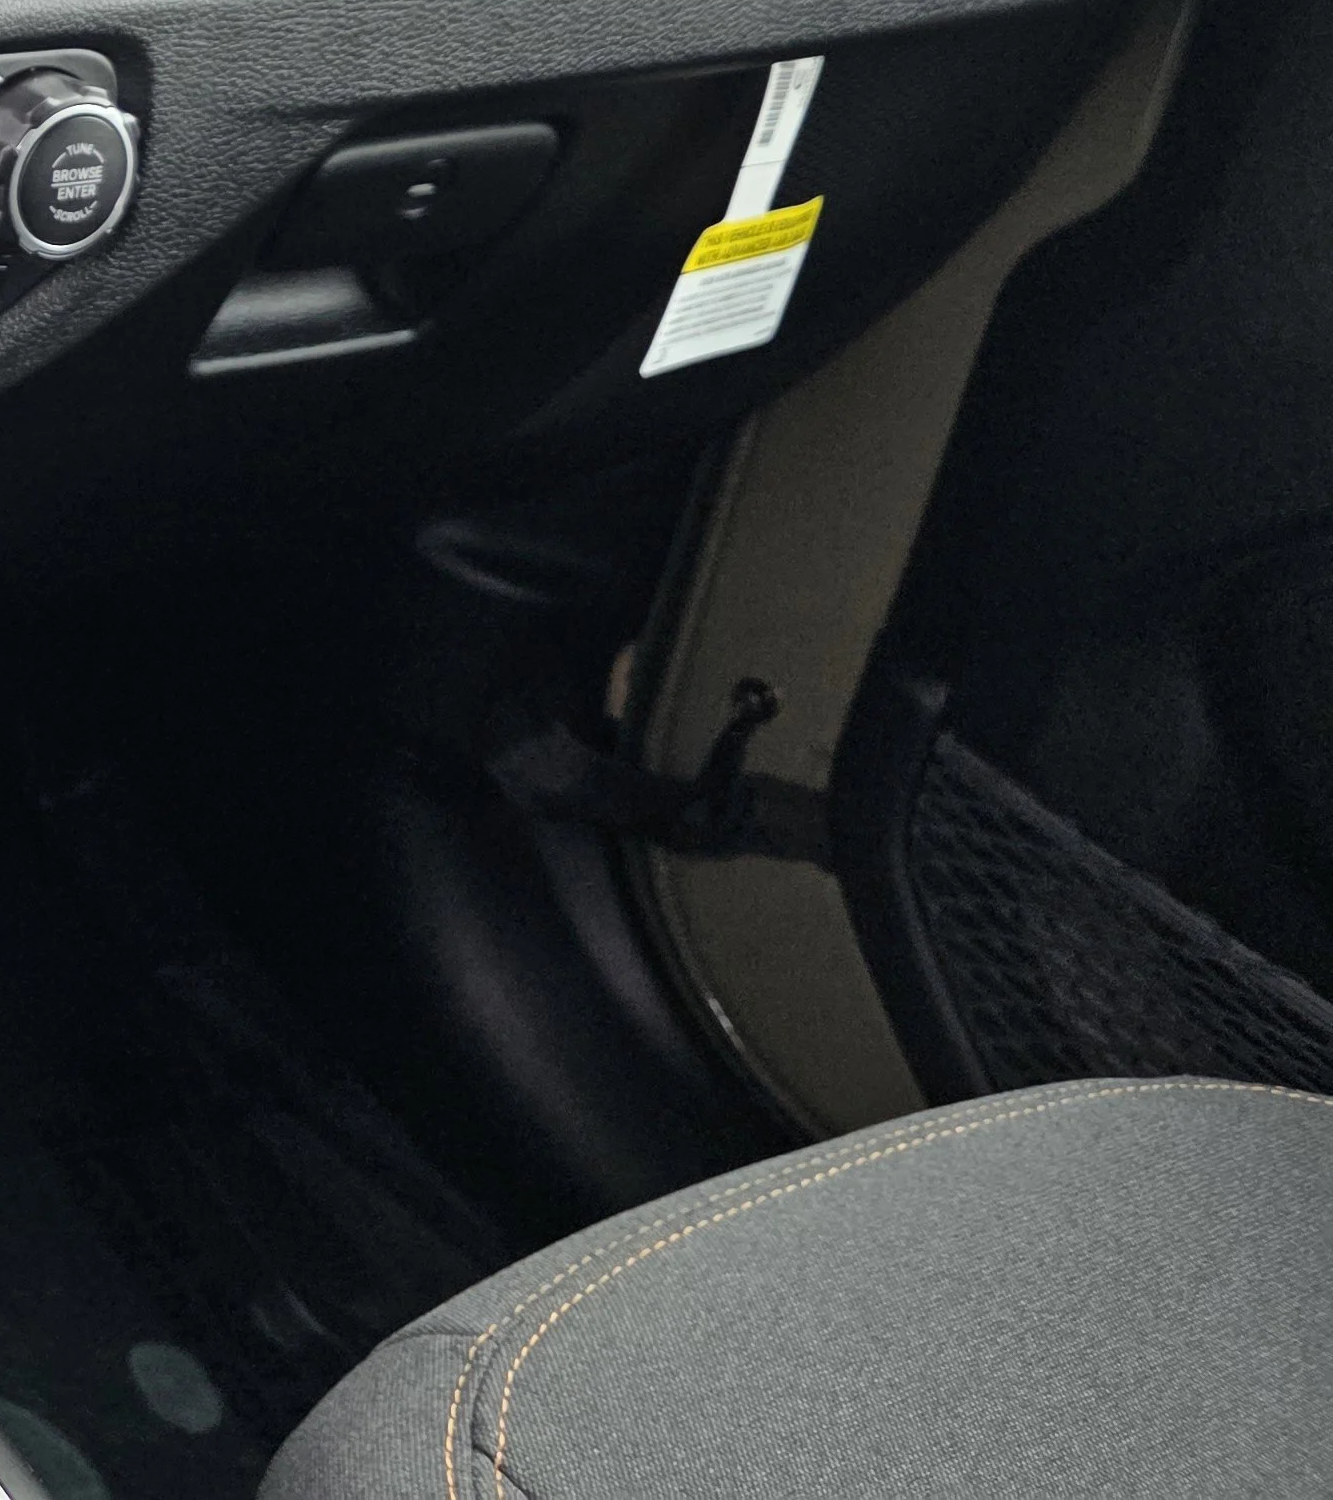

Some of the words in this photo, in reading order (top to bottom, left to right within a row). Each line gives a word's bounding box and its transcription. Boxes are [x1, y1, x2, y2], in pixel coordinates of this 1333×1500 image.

[66, 143, 94, 156] TUNE
[52, 165, 103, 182] BROWSE
[57, 184, 96, 200] ENTER
[53, 206, 93, 222] SCROLL
